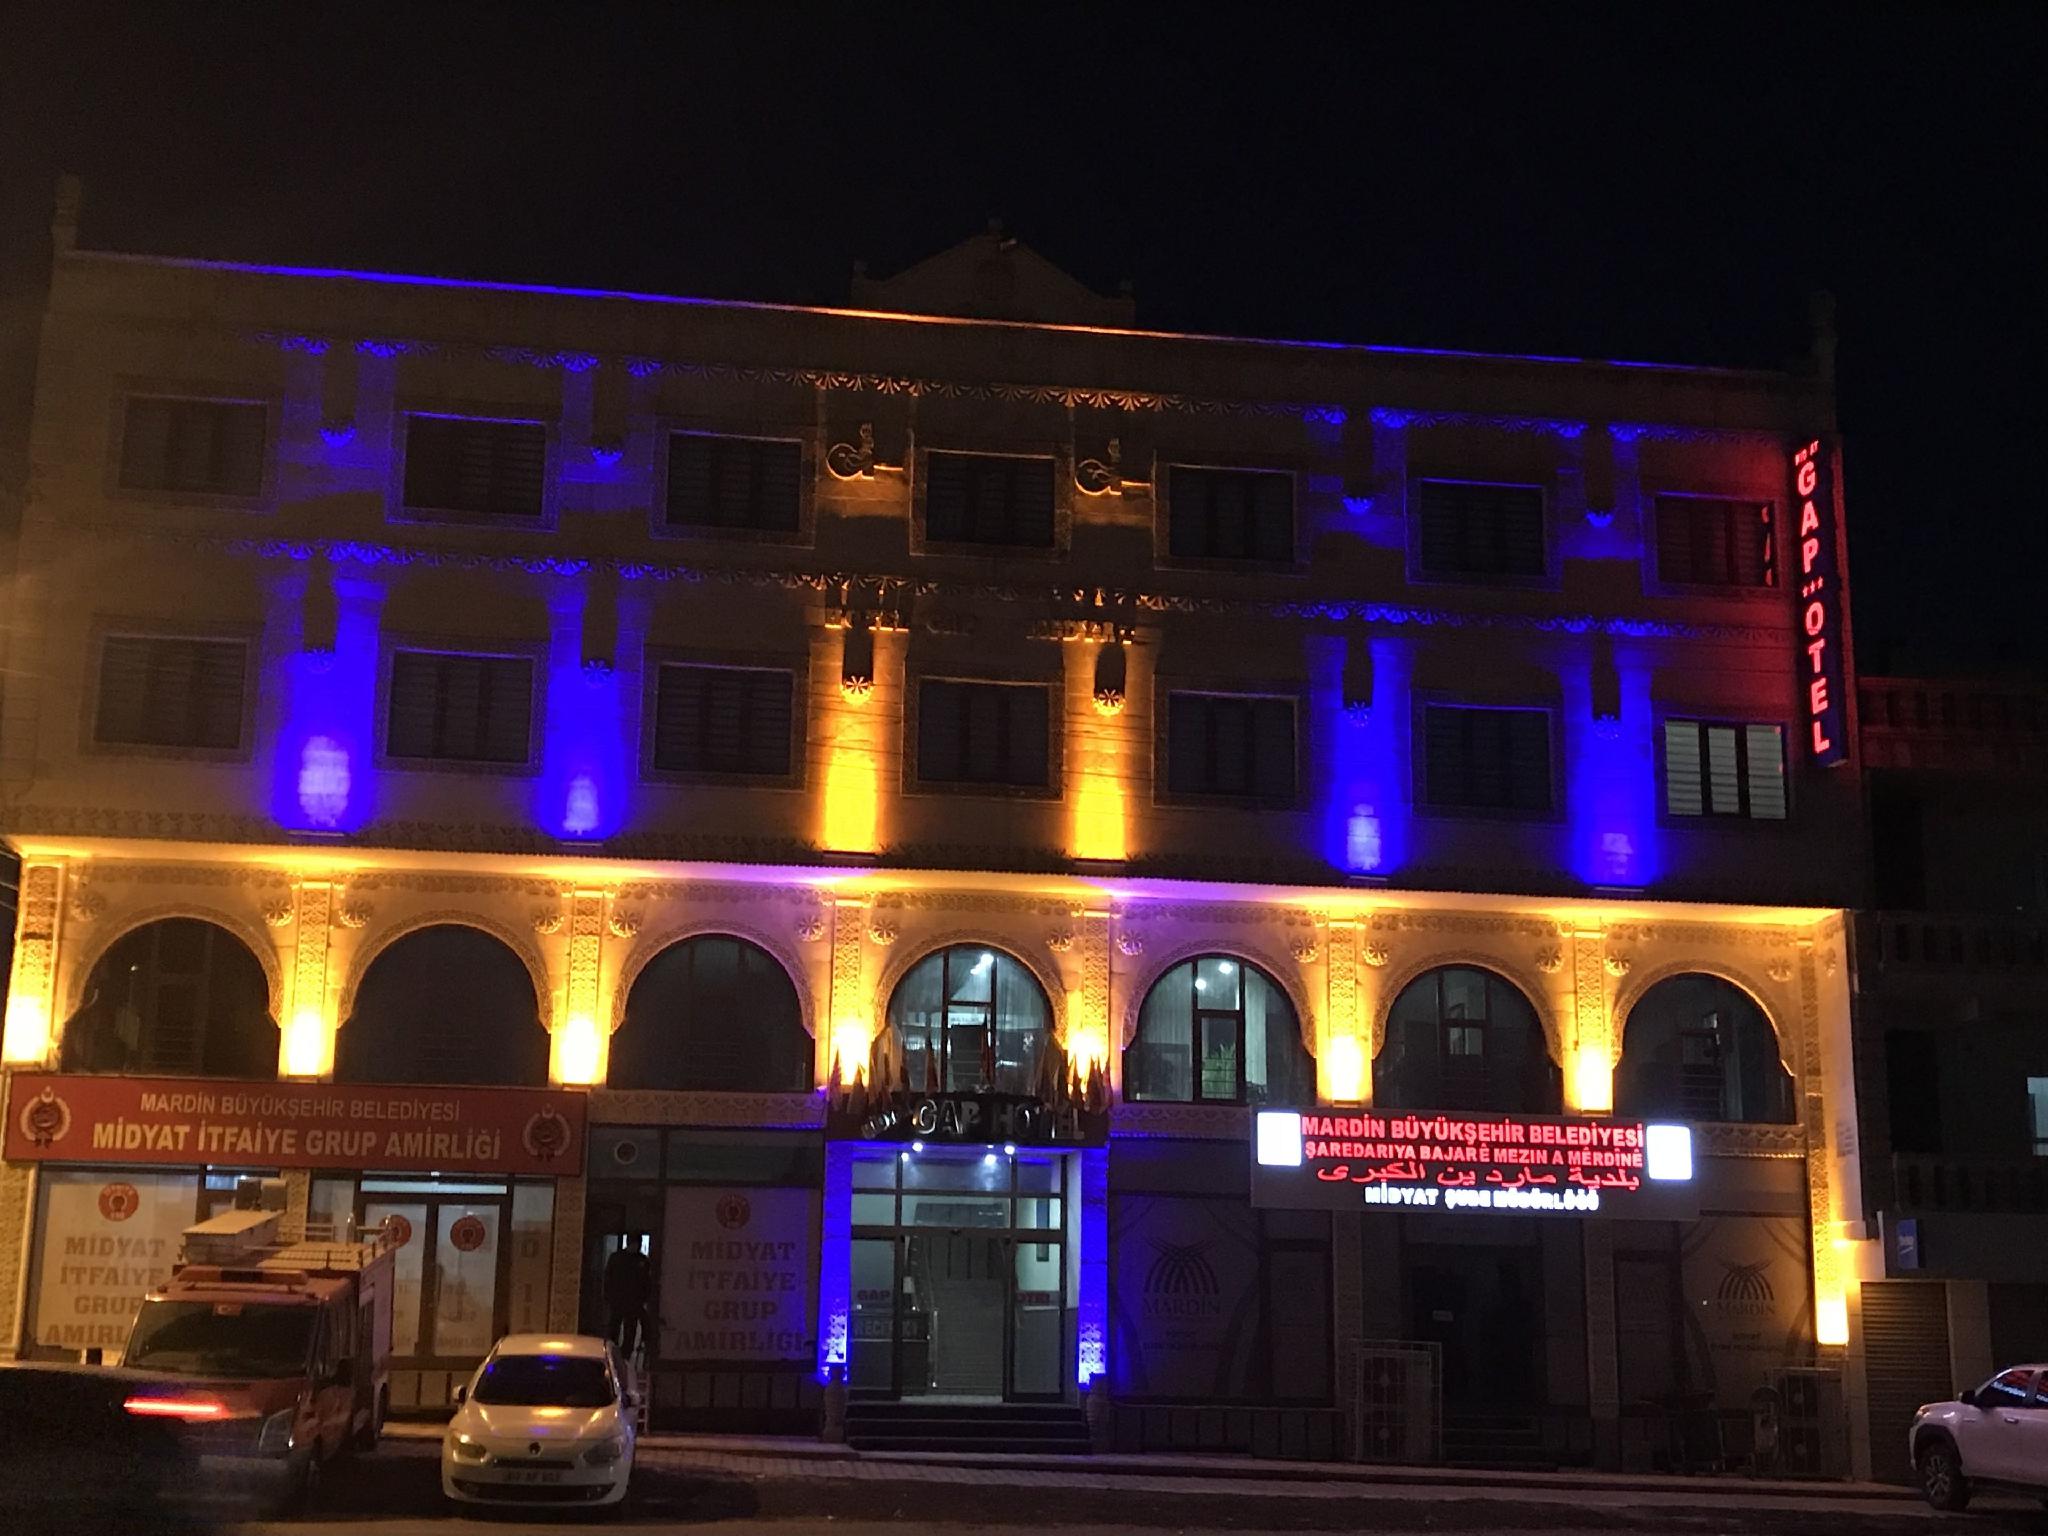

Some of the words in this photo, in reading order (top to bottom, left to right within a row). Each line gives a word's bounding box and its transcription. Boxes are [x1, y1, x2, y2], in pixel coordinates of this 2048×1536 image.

[1798, 460, 1819, 573] GAP
[1805, 601, 1831, 754] OTEL
[141, 1093, 215, 1113] MARDİN
[221, 1094, 344, 1118] BÜYÜKŞEHİR
[350, 1098, 460, 1121] BELEDİYESİ
[917, 1099, 981, 1135] GAP
[92, 1116, 190, 1150] MİDYAT
[199, 1119, 298, 1154] İTFAİYE
[306, 1129, 377, 1156] GRUP
[384, 1126, 501, 1160] AMİRLİĞİ
[1302, 1114, 1386, 1138] MARDİN
[1391, 1115, 1525, 1145] BÜYÜKŞEHİR
[1530, 1121, 1644, 1148] BELEDİYESİ
[1305, 1141, 1416, 1159] ŞAREDARIYA
[1420, 1143, 1490, 1162] BAJARÊ
[1494, 1148, 1548, 1164] MEZIN
[1552, 1150, 1564, 1165] A
[1568, 1147, 1643, 1167] MÊRDÎNÊ
[703, 1301, 778, 1320] GRUP
